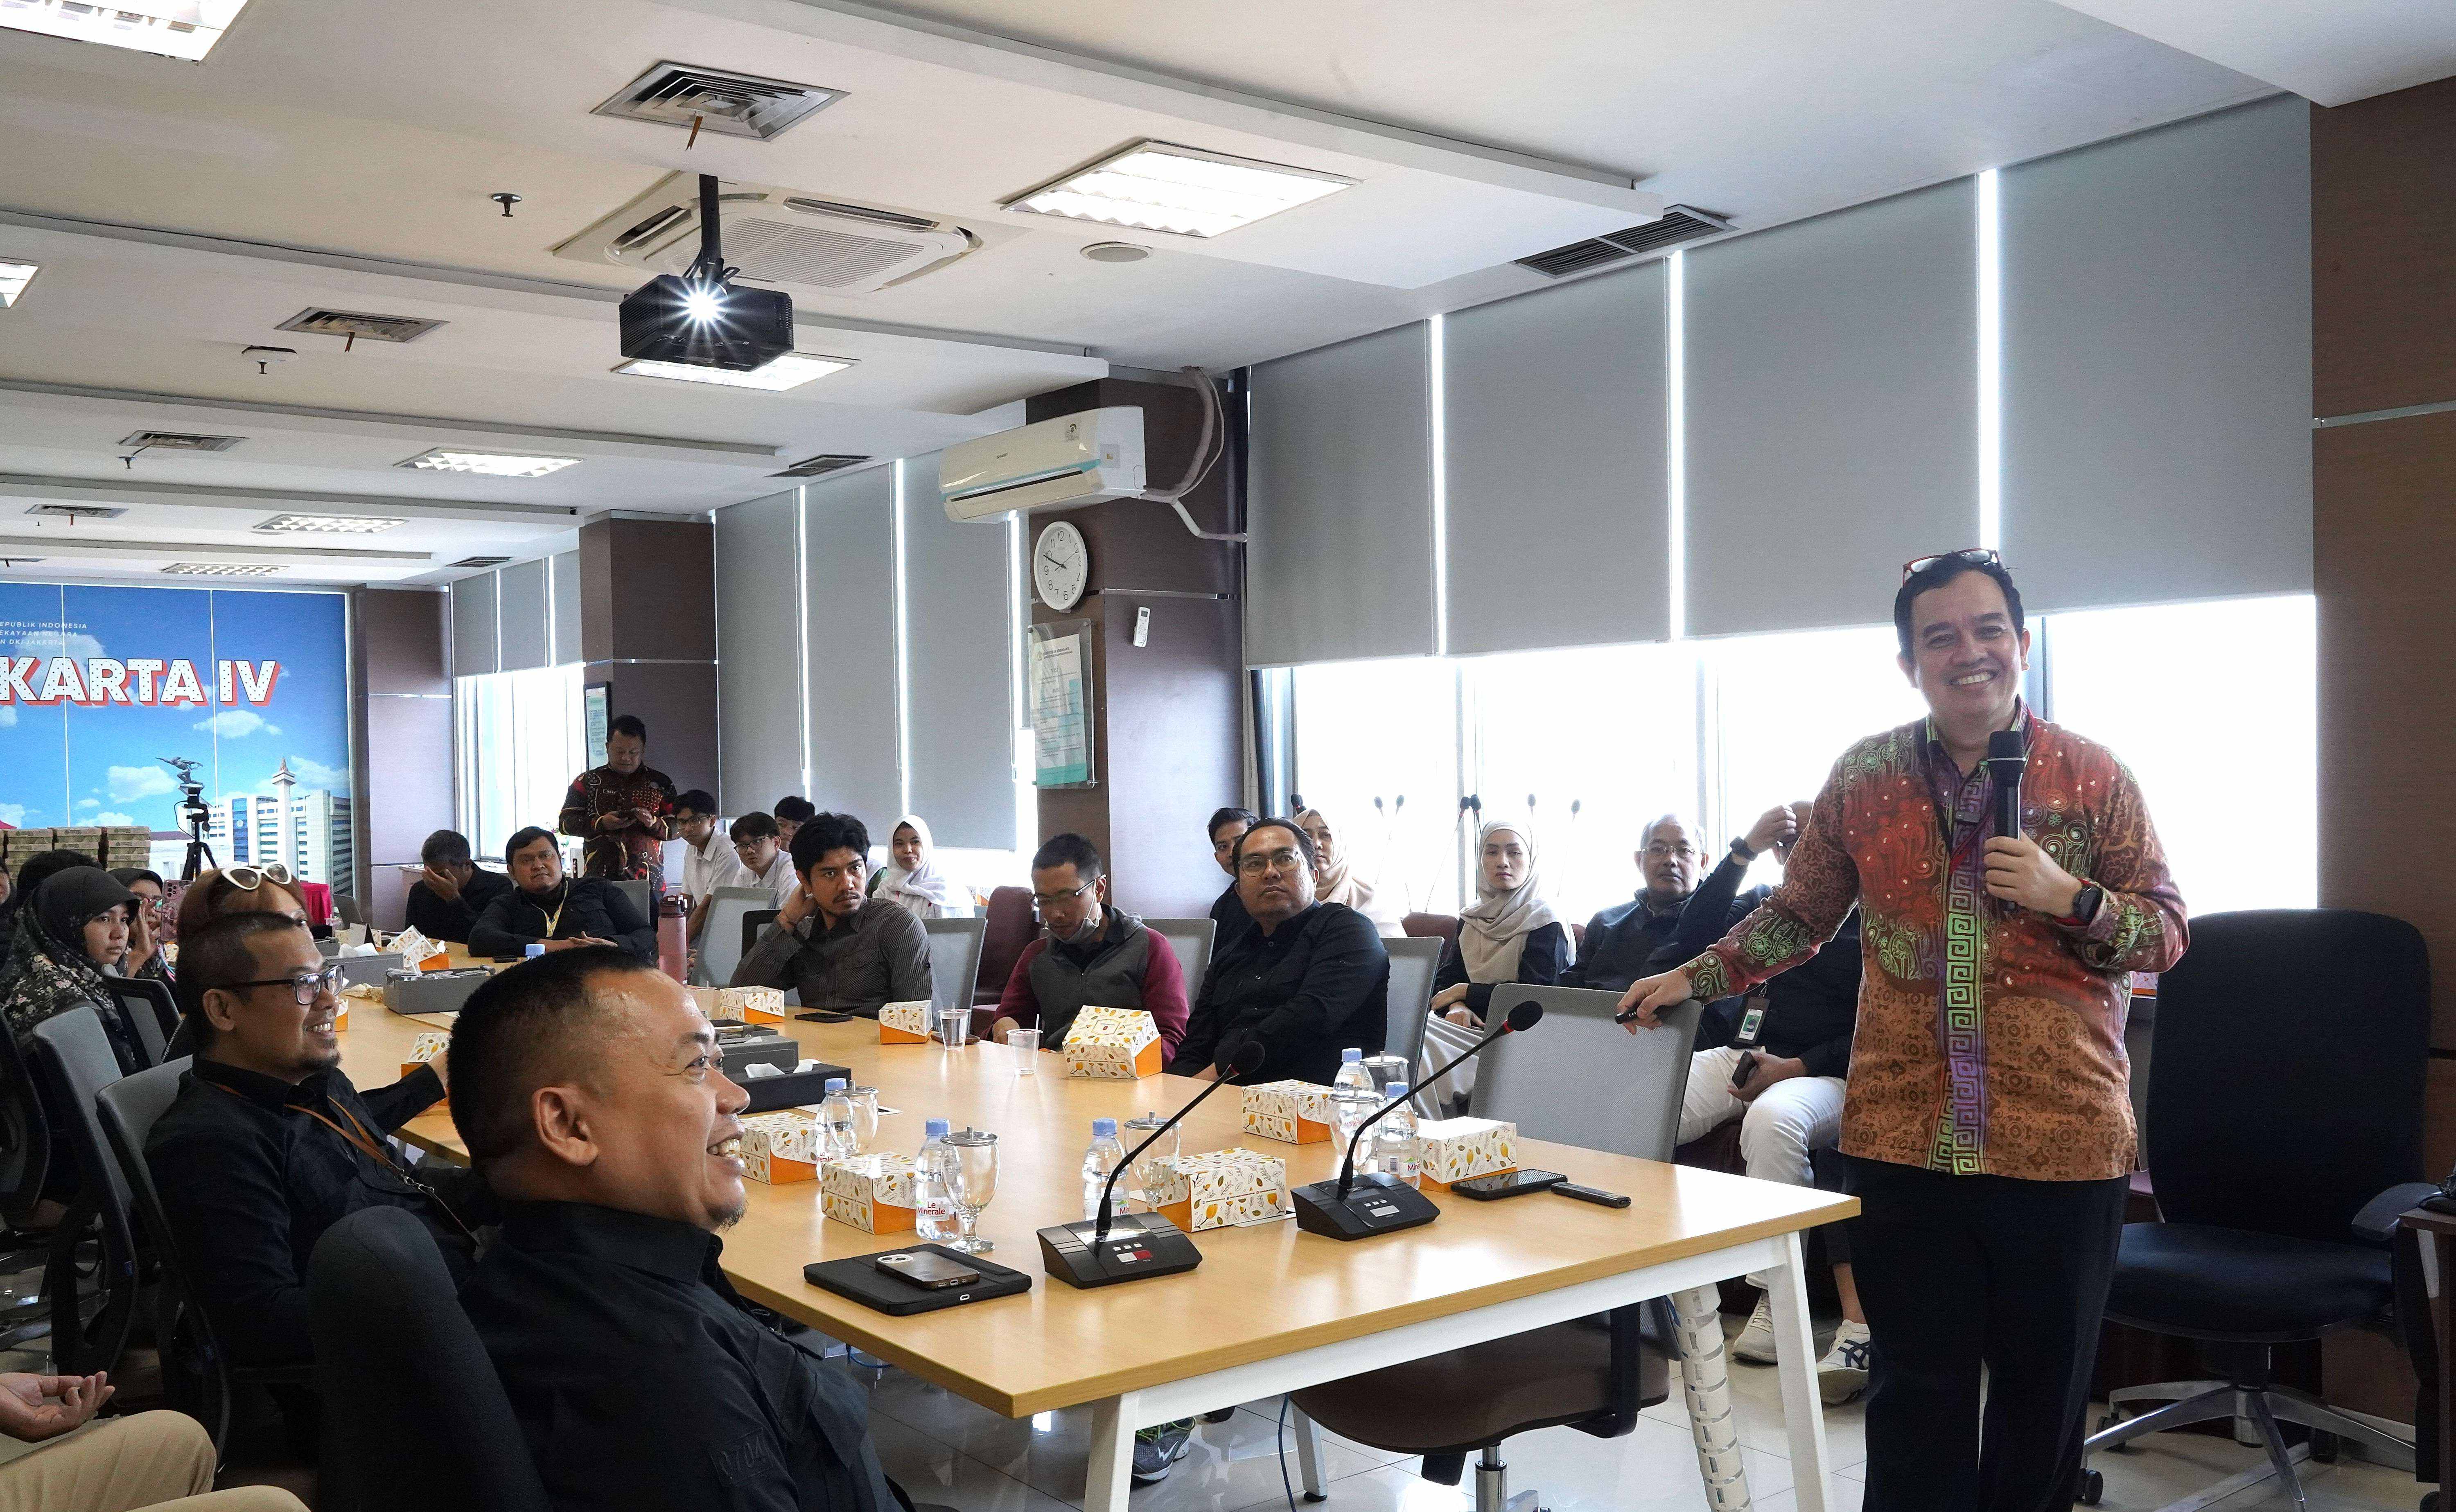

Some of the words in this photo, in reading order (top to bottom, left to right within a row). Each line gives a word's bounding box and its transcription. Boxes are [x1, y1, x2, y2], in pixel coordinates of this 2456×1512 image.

[1057, 530, 1065, 542] 12
[1069, 533, 1071, 544] 1
[1050, 539, 1055, 548] 11
[1044, 565, 1049, 575] 9
[1048, 580, 1053, 590] 8
[1071, 584, 1077, 594] 5
[1054, 589, 1059, 598] 7
[1063, 591, 1069, 600] 6
[218, 659, 281, 706] IV
[927, 1201, 936, 1209] Le
[917, 1206, 946, 1215] Minerale
